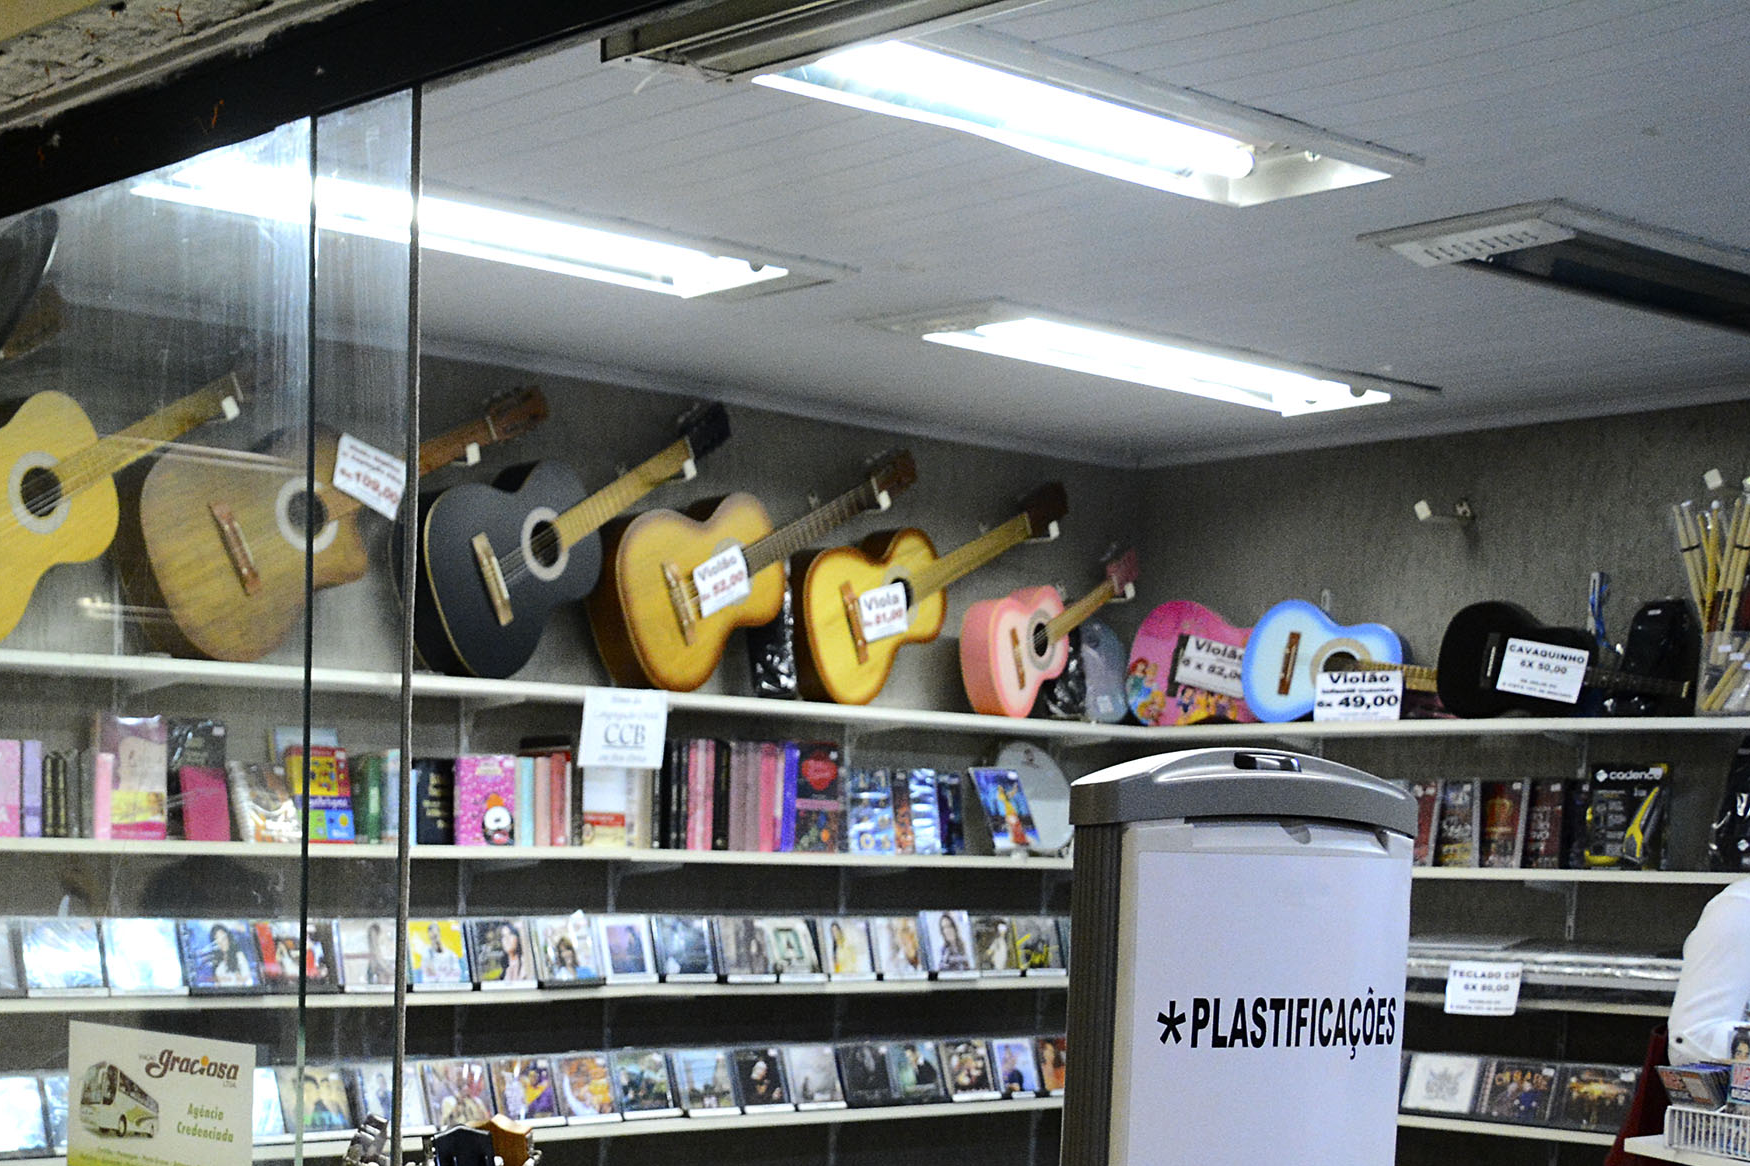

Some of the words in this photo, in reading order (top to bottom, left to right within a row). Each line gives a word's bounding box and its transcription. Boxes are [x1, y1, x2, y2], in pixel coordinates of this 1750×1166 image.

[1509, 644, 1585, 664] CAVAQUINHO
[1330, 671, 1390, 684] Violão
[1338, 695, 1398, 710] 49,00
[603, 723, 646, 746] CCB
[1452, 969, 1502, 980] TECLADO
[187, 1103, 224, 1121] Agência
[176, 1121, 235, 1144] Credenciada
